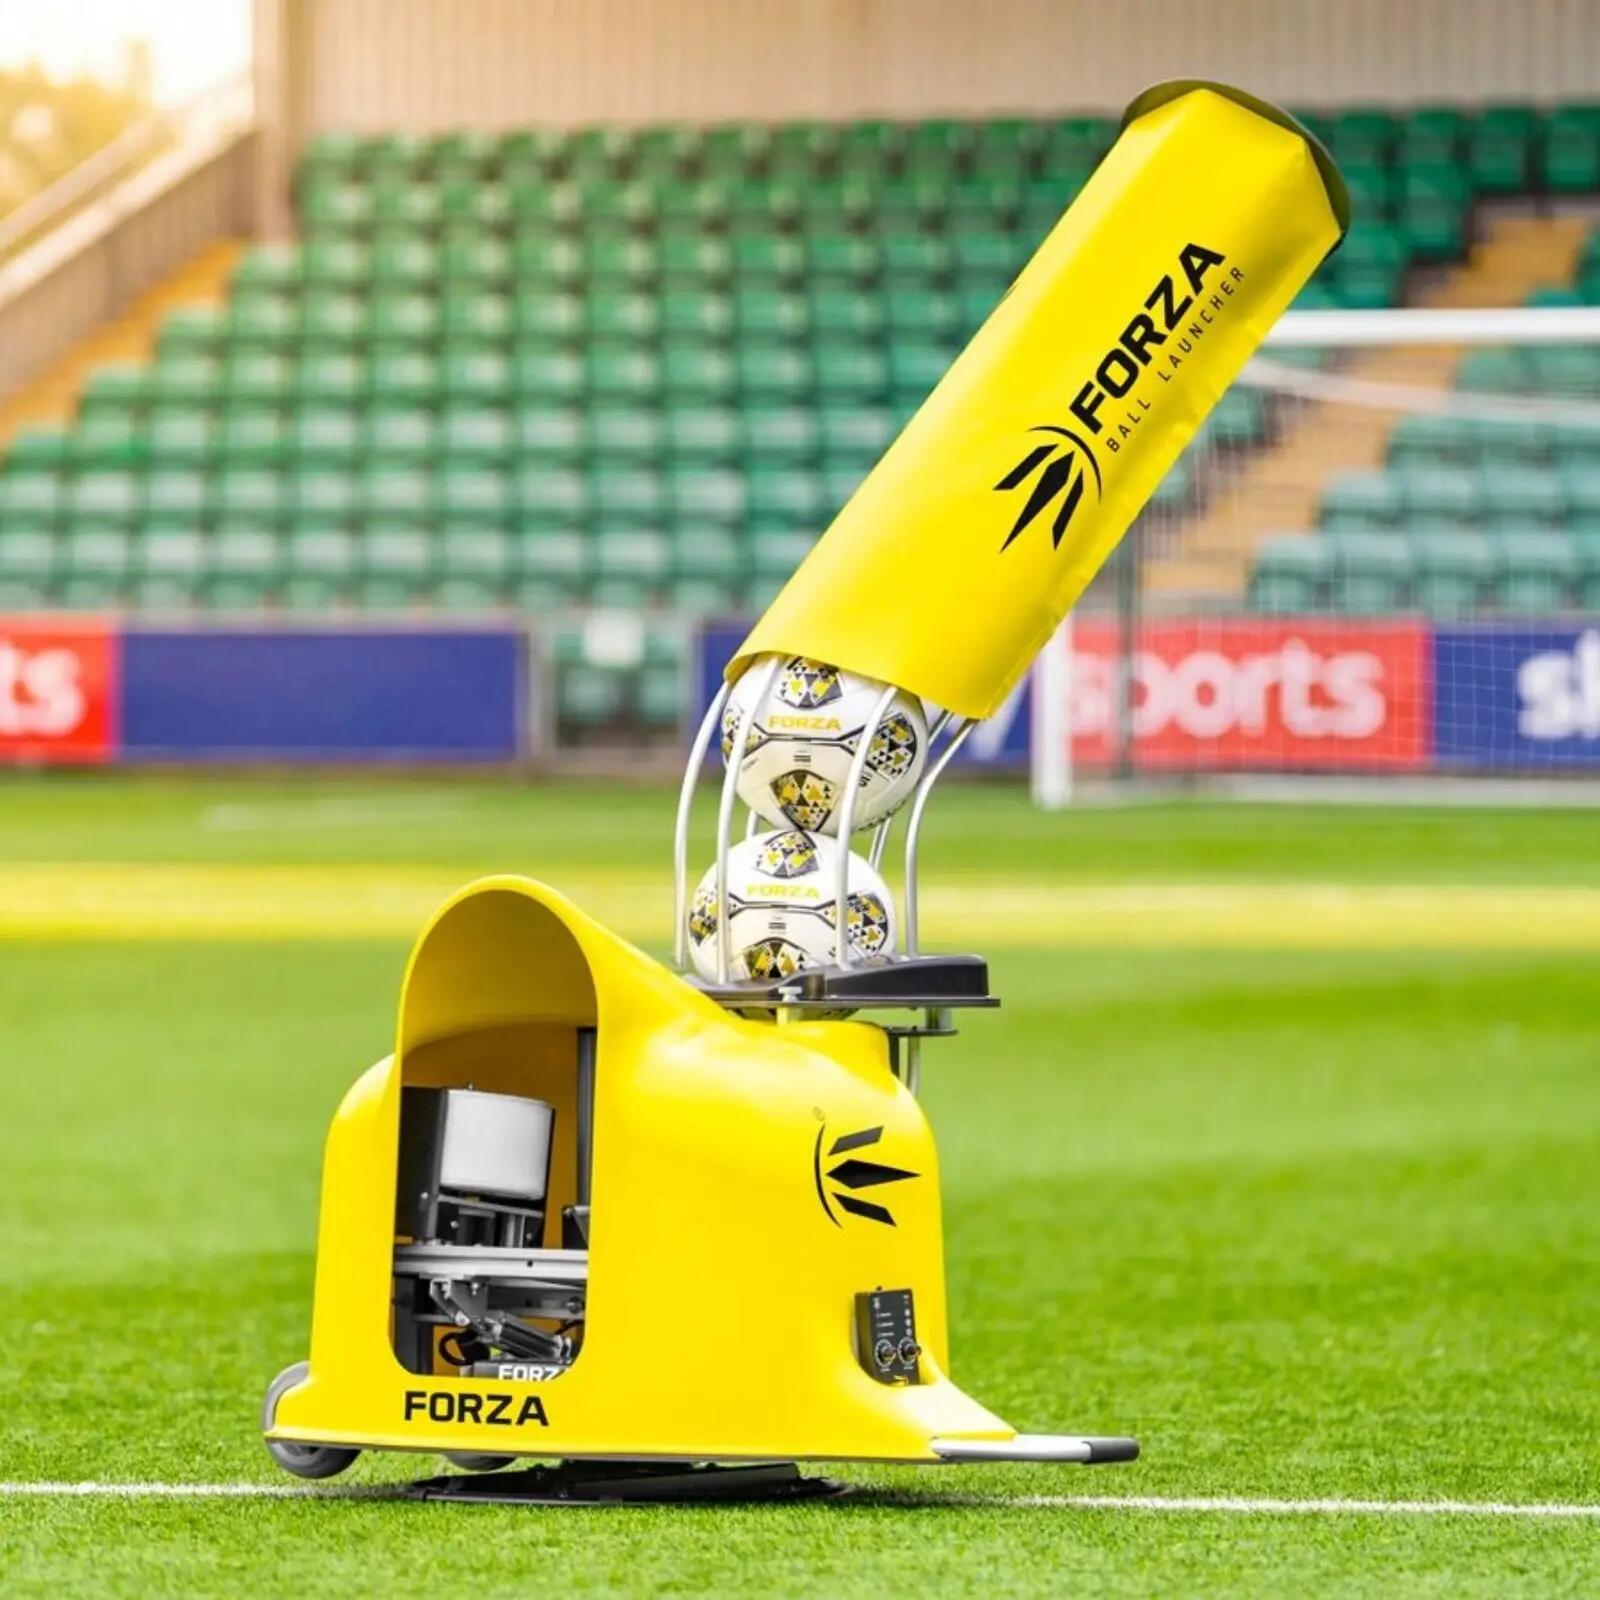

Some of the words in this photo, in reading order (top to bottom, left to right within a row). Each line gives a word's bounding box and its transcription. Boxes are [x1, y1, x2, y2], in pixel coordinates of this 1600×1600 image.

[1069, 243, 1226, 434] FORZA
[1106, 399, 1151, 452] BALL
[1157, 266, 1245, 382] LAUNCHER
[767, 715, 842, 732] FORZA
[746, 884, 821, 899] FORZA
[404, 1390, 549, 1427] FORZA
